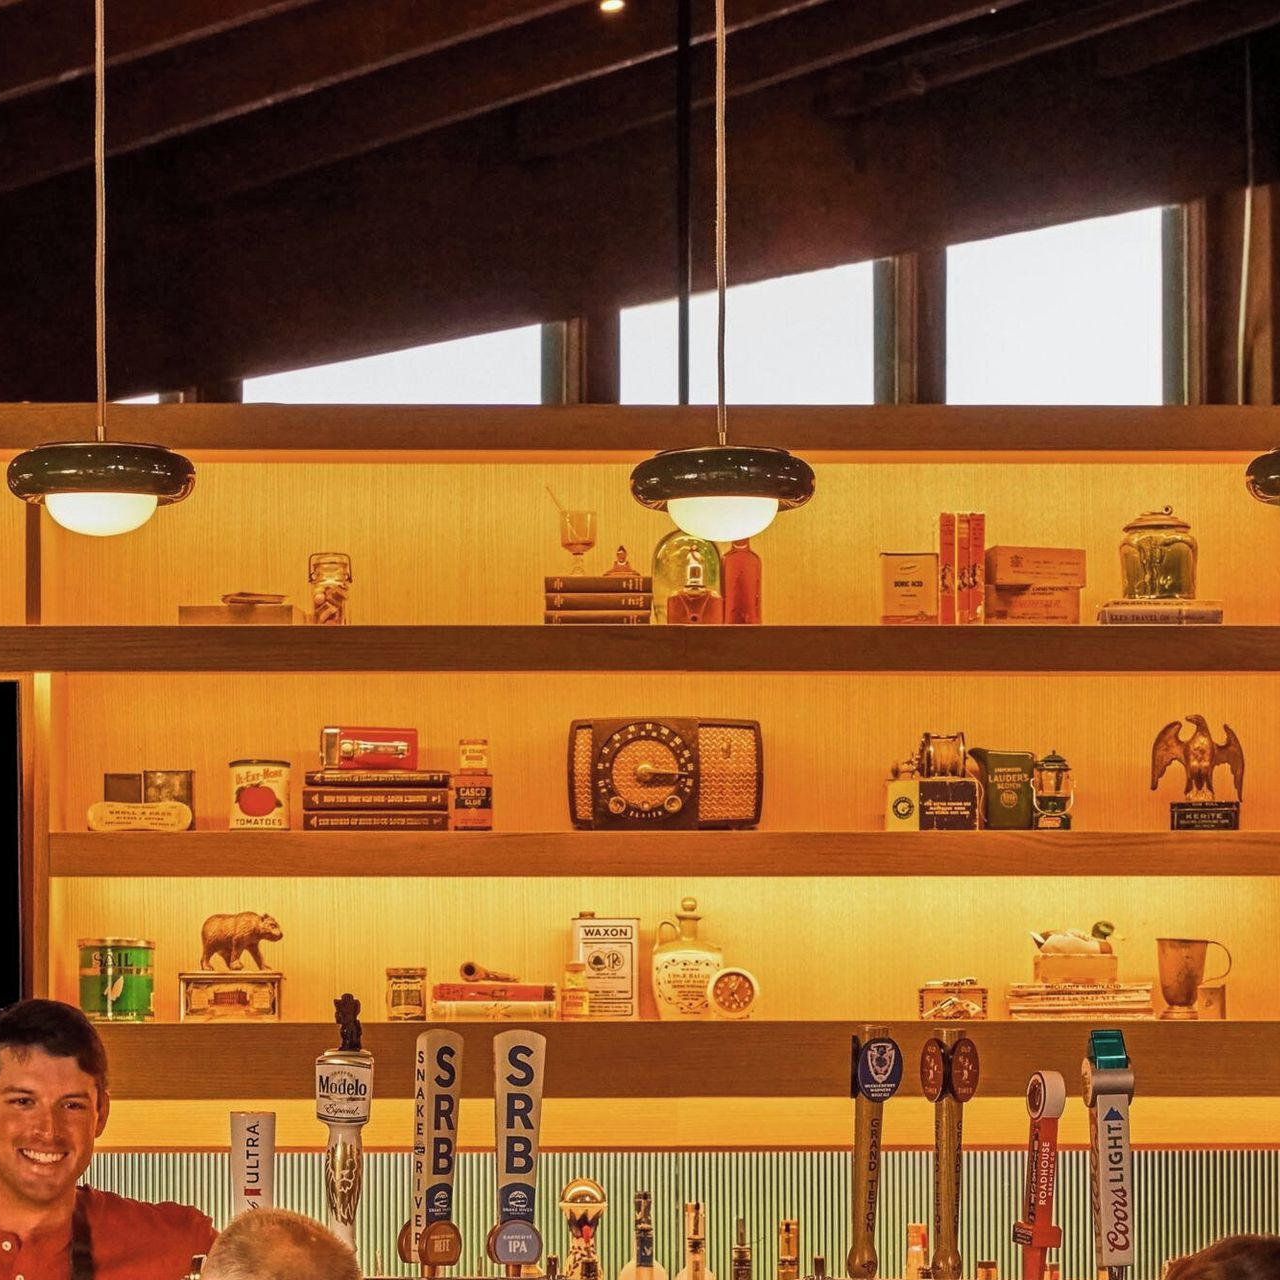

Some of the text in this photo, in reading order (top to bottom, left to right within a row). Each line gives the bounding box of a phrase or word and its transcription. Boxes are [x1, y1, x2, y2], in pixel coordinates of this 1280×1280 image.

[236, 818, 283, 827] TOMATOES
[583, 928, 628, 937] WAXON
[92, 952, 133, 967] SAIL
[319, 1075, 368, 1096] Modelo
[416, 1051, 425, 1136] SNAKE
[324, 1103, 360, 1116] Especial
[506, 1045, 535, 1174] SRB
[246, 1123, 260, 1184] ULTRA
[1039, 1141, 1051, 1206] ROADHOUSE
[866, 1118, 880, 1233] GRAND TETON
[1107, 1123, 1130, 1252] Coors LIGHT
[508, 1240, 528, 1253] IPA
